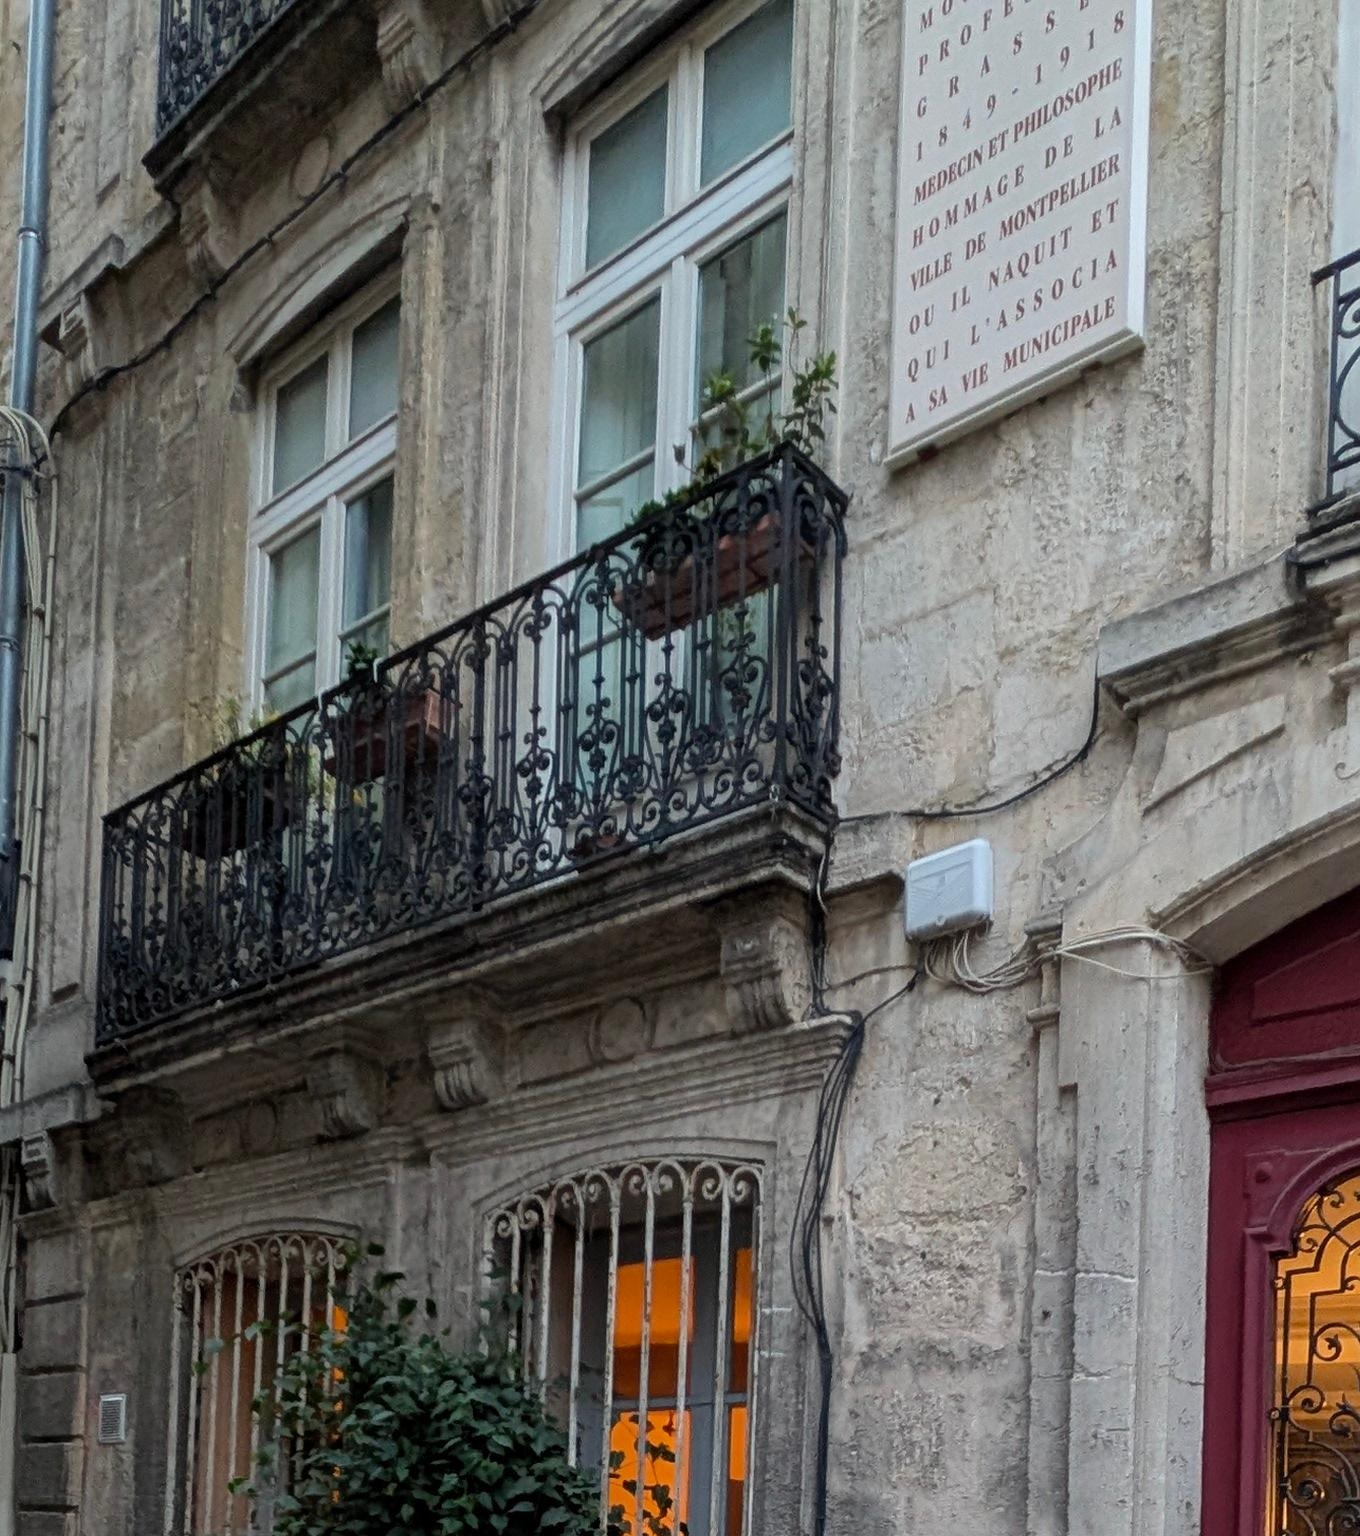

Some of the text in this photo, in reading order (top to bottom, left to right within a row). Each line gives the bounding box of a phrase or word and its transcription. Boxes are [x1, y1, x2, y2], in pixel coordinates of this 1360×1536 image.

[918, 0, 1033, 76] PROFE
[919, 0, 970, 33] MO
[912, 105, 1122, 249] HOMMAGE DE LA
[913, 57, 1123, 206] MEDECIN ET PHILOSOPHE
[908, 198, 1120, 336] OU IL NAQUIT ET
[910, 152, 1120, 292] VILLE DE MONTPELLIER
[904, 295, 1116, 424] A SA VIE MUNICIPALE
[907, 248, 1118, 384] QUI L'ASSOCIA
